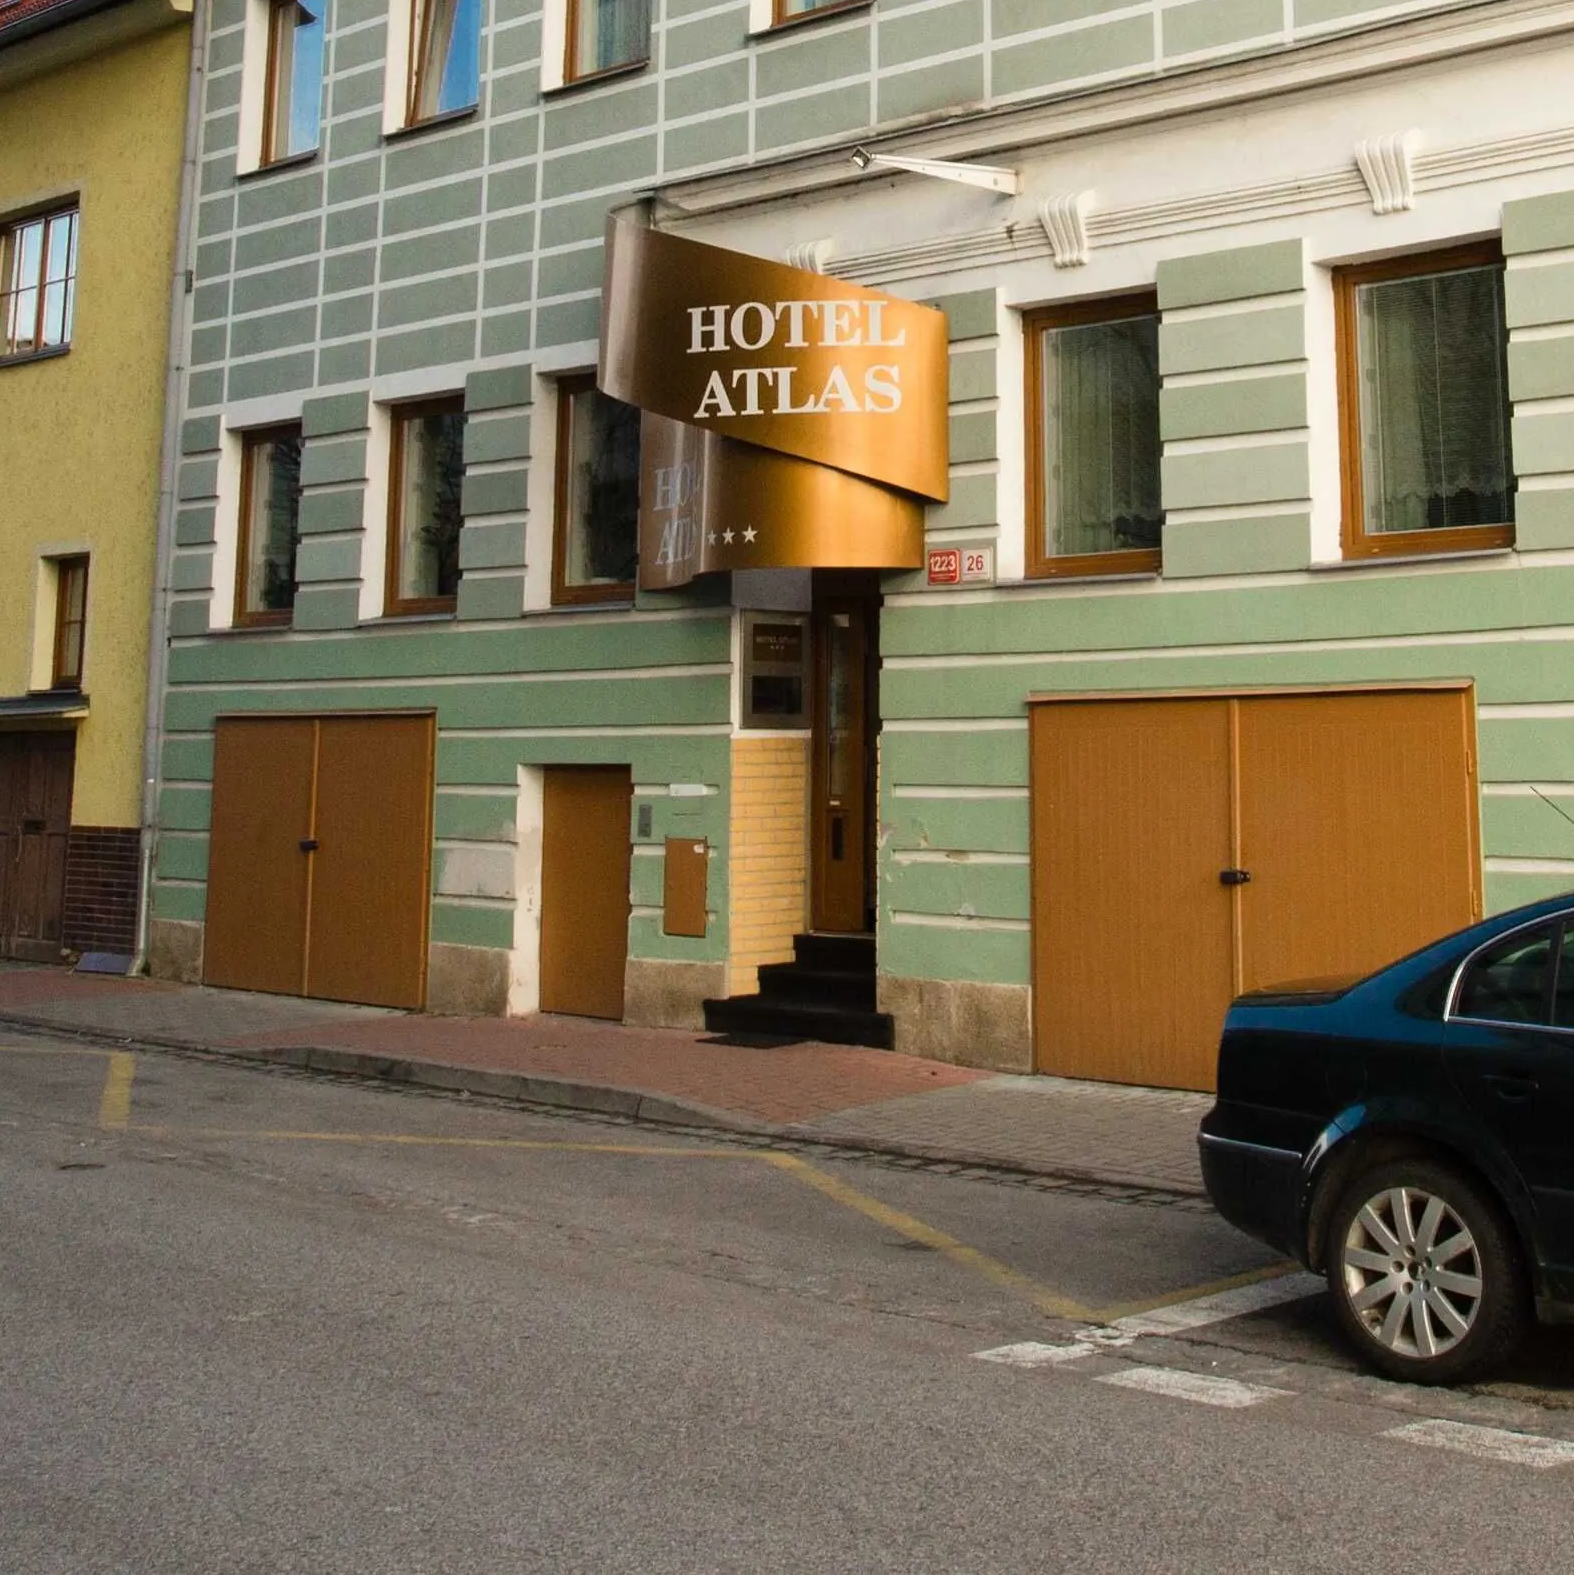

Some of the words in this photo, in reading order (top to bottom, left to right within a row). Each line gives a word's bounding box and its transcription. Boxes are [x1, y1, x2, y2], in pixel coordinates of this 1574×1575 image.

[686, 299, 906, 354] HOTEL
[693, 364, 902, 418] ATLAS
[930, 554, 956, 573] 1223
[967, 554, 984, 572] 26
